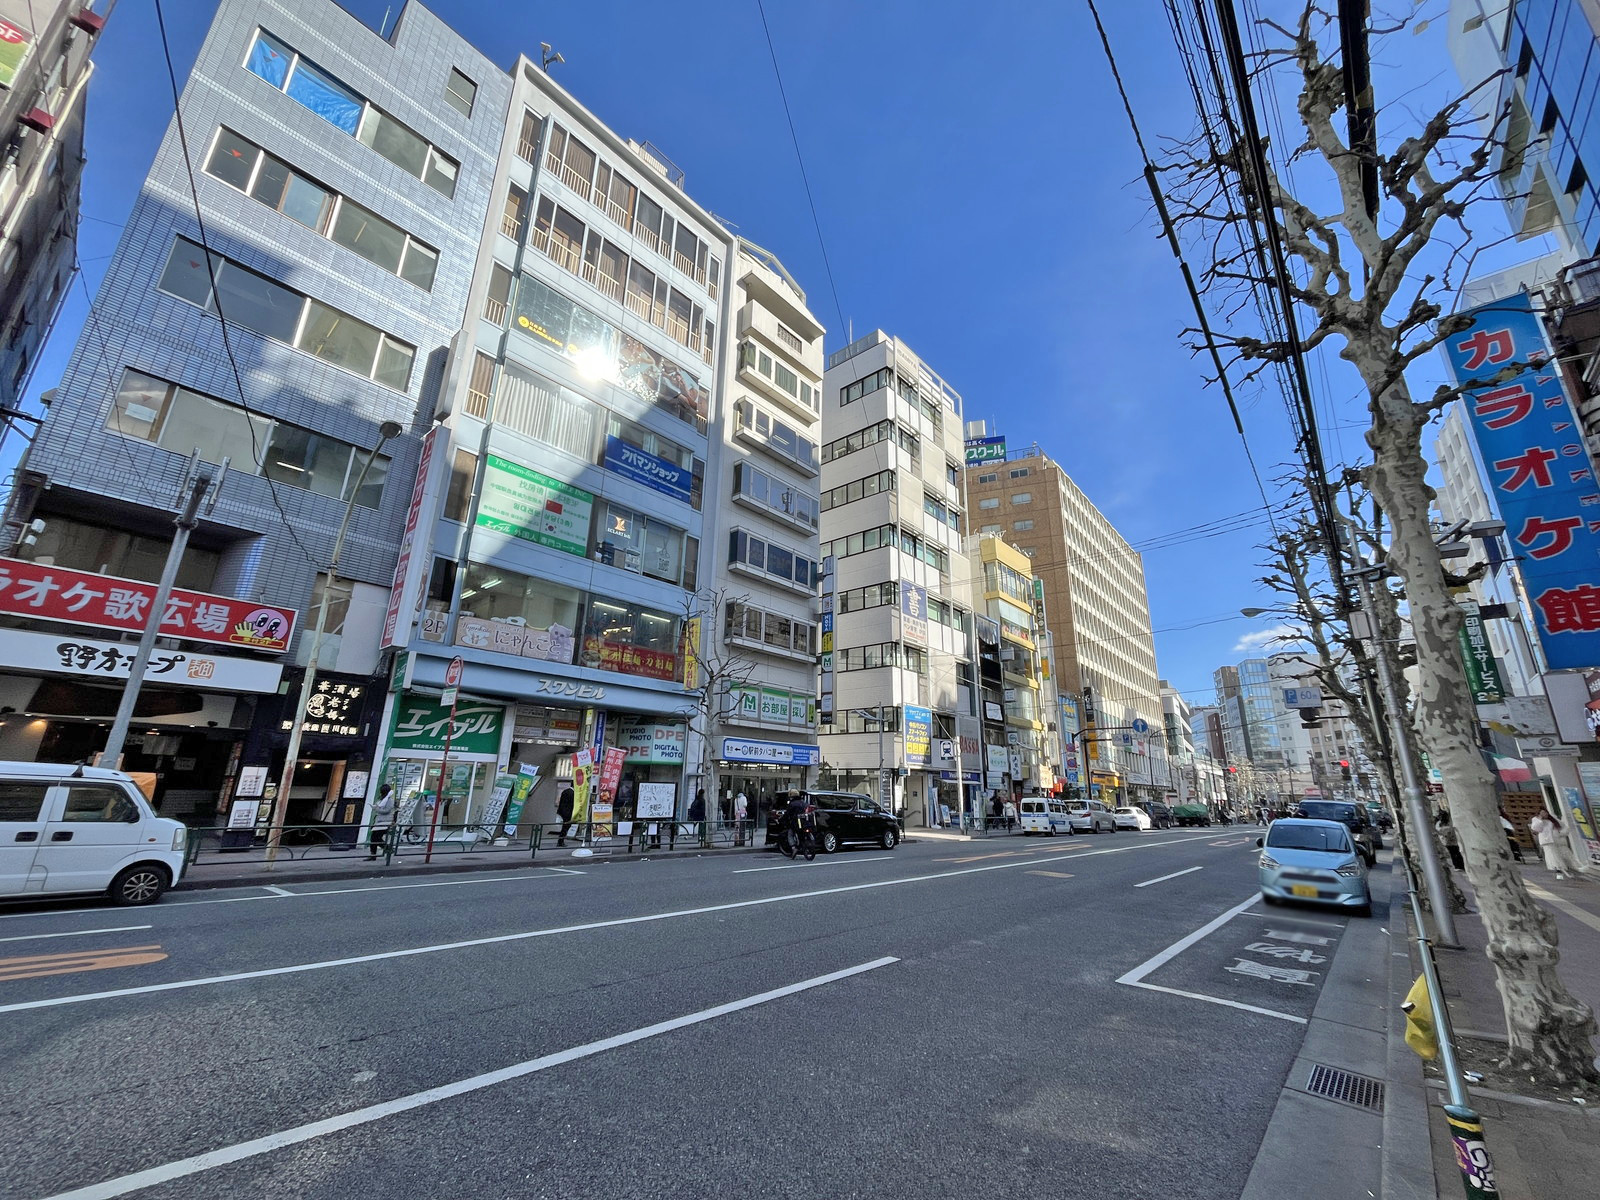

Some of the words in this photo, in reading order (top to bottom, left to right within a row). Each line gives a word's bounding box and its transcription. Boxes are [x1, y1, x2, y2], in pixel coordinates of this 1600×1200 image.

[494, 459, 507, 468] The
[507, 463, 546, 484] room-finding
[621, 448, 680, 483] アパマンショップ
[1458, 328, 1600, 636] カラオケ館
[487, 519, 512, 533] エイブル
[424, 618, 444, 634] 2F
[495, 630, 561, 654] にゃんこと
[1465, 616, 1498, 690] 印刷加工サービス
[536, 679, 606, 699] スワンビル
[394, 707, 502, 740] エイブル
[654, 729, 685, 741] DPE
[654, 744, 679, 752] DIGITAL
